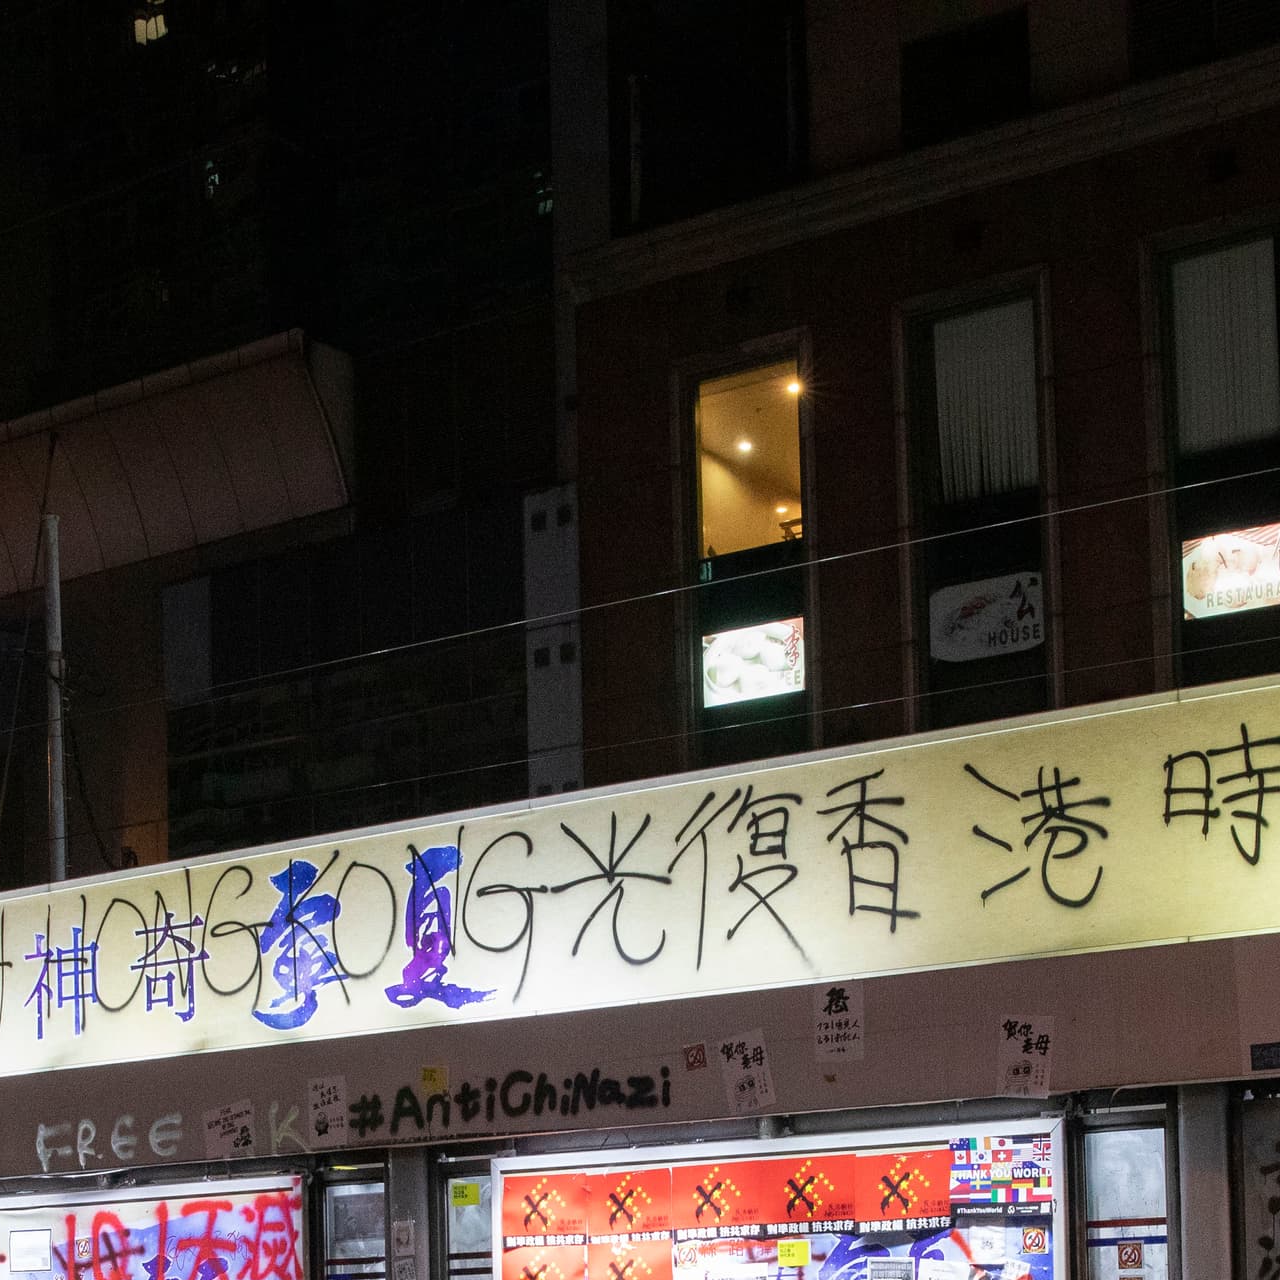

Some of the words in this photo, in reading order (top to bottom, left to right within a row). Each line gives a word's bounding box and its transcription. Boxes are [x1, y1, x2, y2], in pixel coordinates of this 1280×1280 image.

[988, 623, 1041, 647] HOUSE
[288, 825, 548, 1006] KONG
[348, 1066, 671, 1138] #AntiChiNazi
[35, 1114, 184, 1173] FREE
[952, 1170, 987, 1179] THANK
[990, 1169, 1011, 1179] YOU
[1013, 1167, 1052, 1178] WORLD
